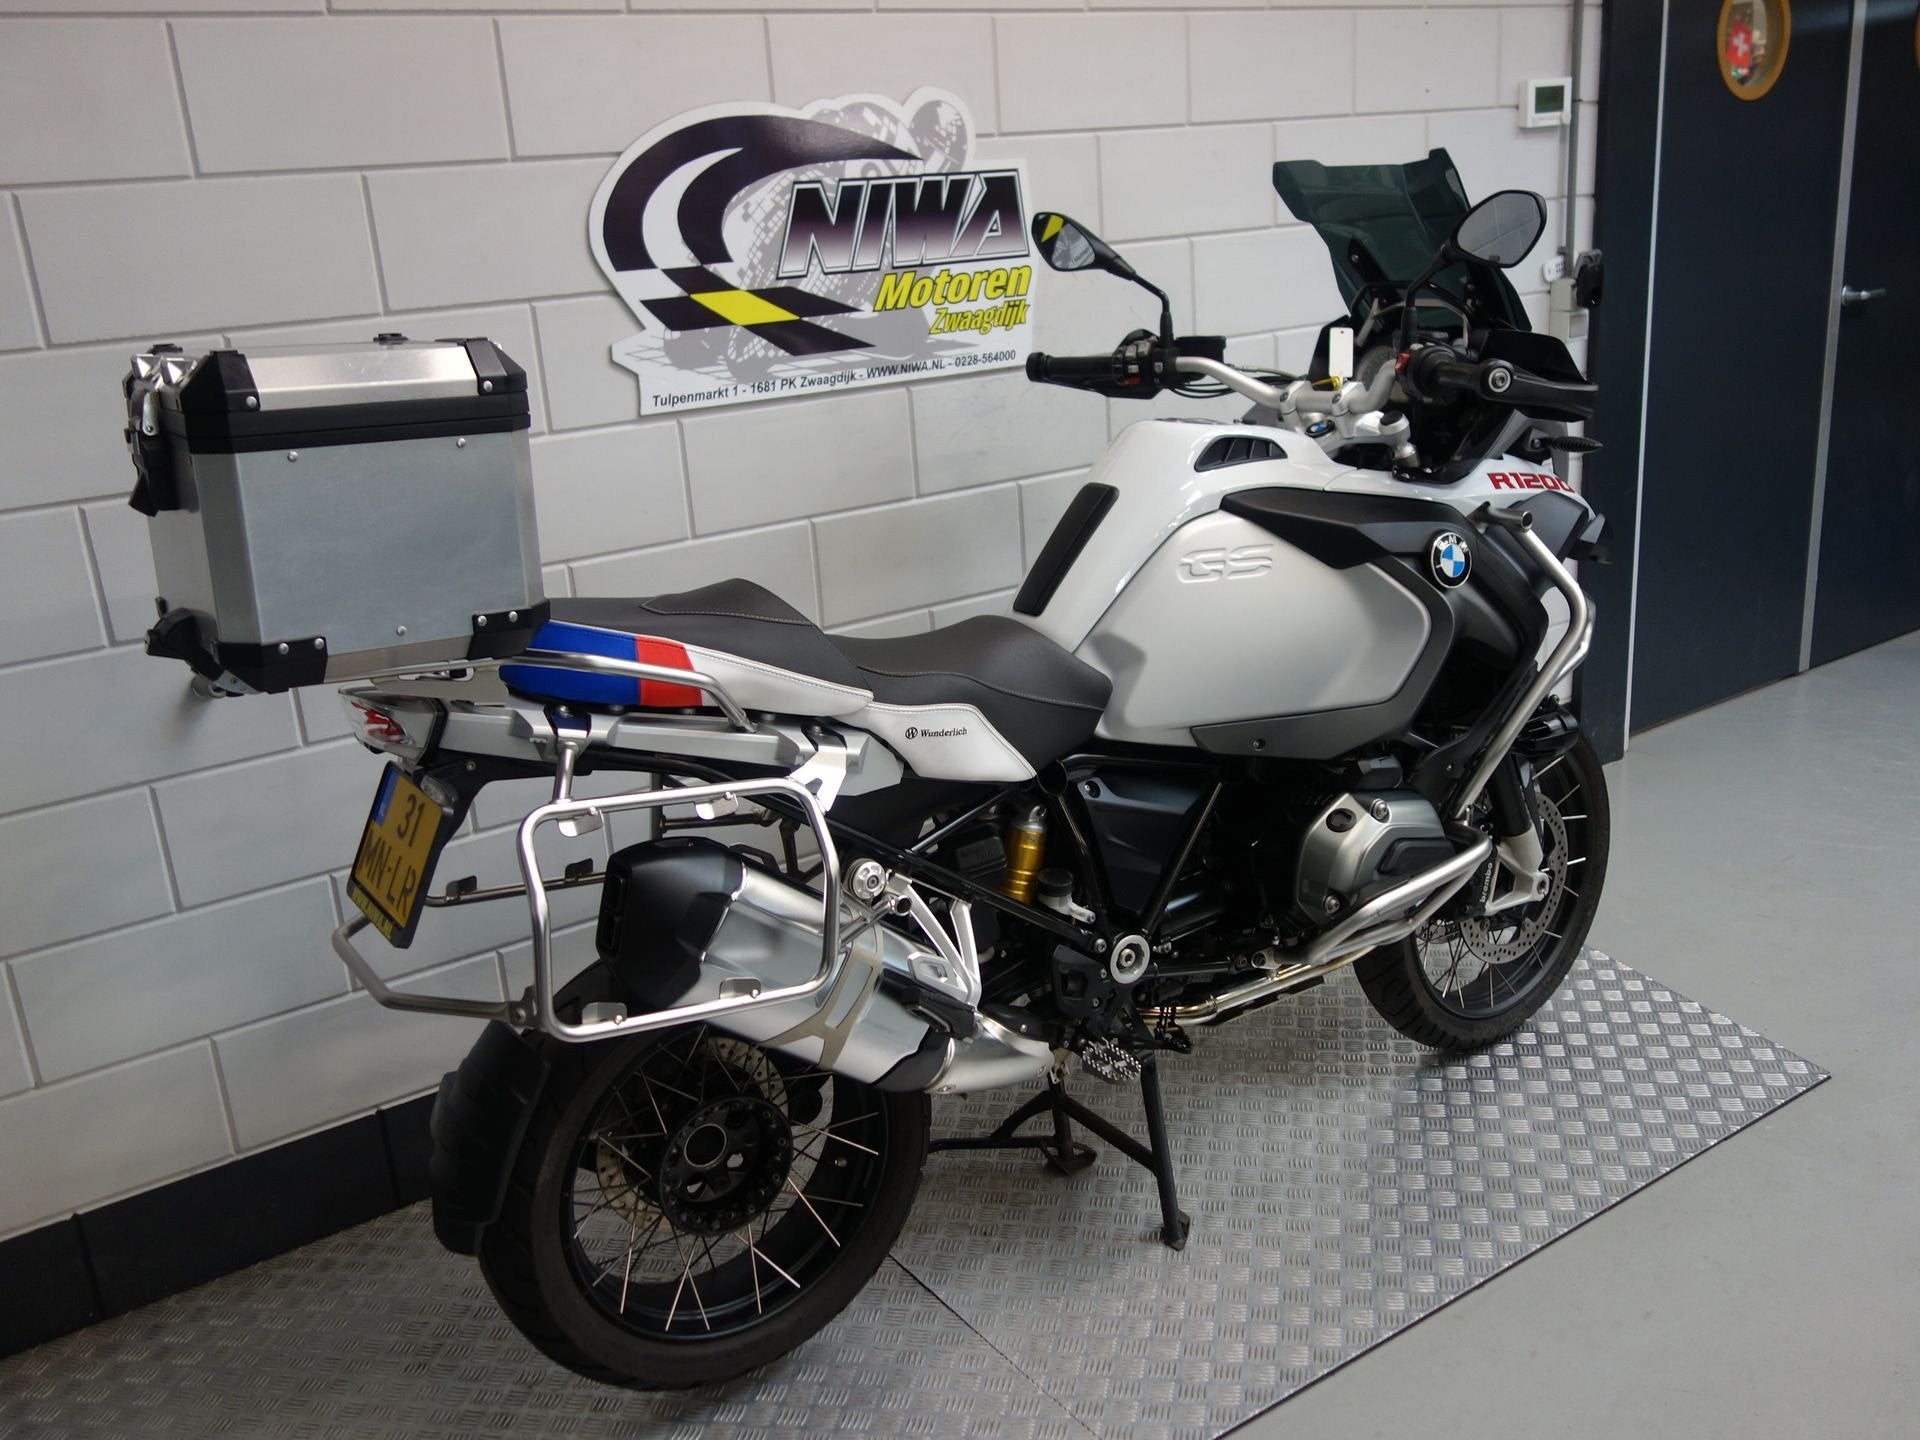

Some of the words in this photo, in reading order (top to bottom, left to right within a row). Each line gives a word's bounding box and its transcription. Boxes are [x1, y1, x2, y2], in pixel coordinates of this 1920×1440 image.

[776, 168, 1030, 280] NIWA
[873, 264, 1032, 312] Motoren
[929, 299, 1031, 335] Zwaagdijk
[652, 388, 729, 408] Tulpenmarkt
[732, 385, 739, 397] 1
[750, 380, 776, 394] 1681
[780, 377, 797, 390] PK
[800, 369, 857, 389] Zwaagdijk
[866, 359, 946, 378] WWW.NIWA.NL
[954, 349, 1017, 368] 0228-564000
[1176, 544, 1273, 583] GS
[1436, 534, 1469, 553] BMW
[920, 727, 968, 738] Wunderlich
[396, 793, 427, 848] 31
[356, 828, 418, 919] MN-LR
[1480, 862, 1493, 903] brembo
